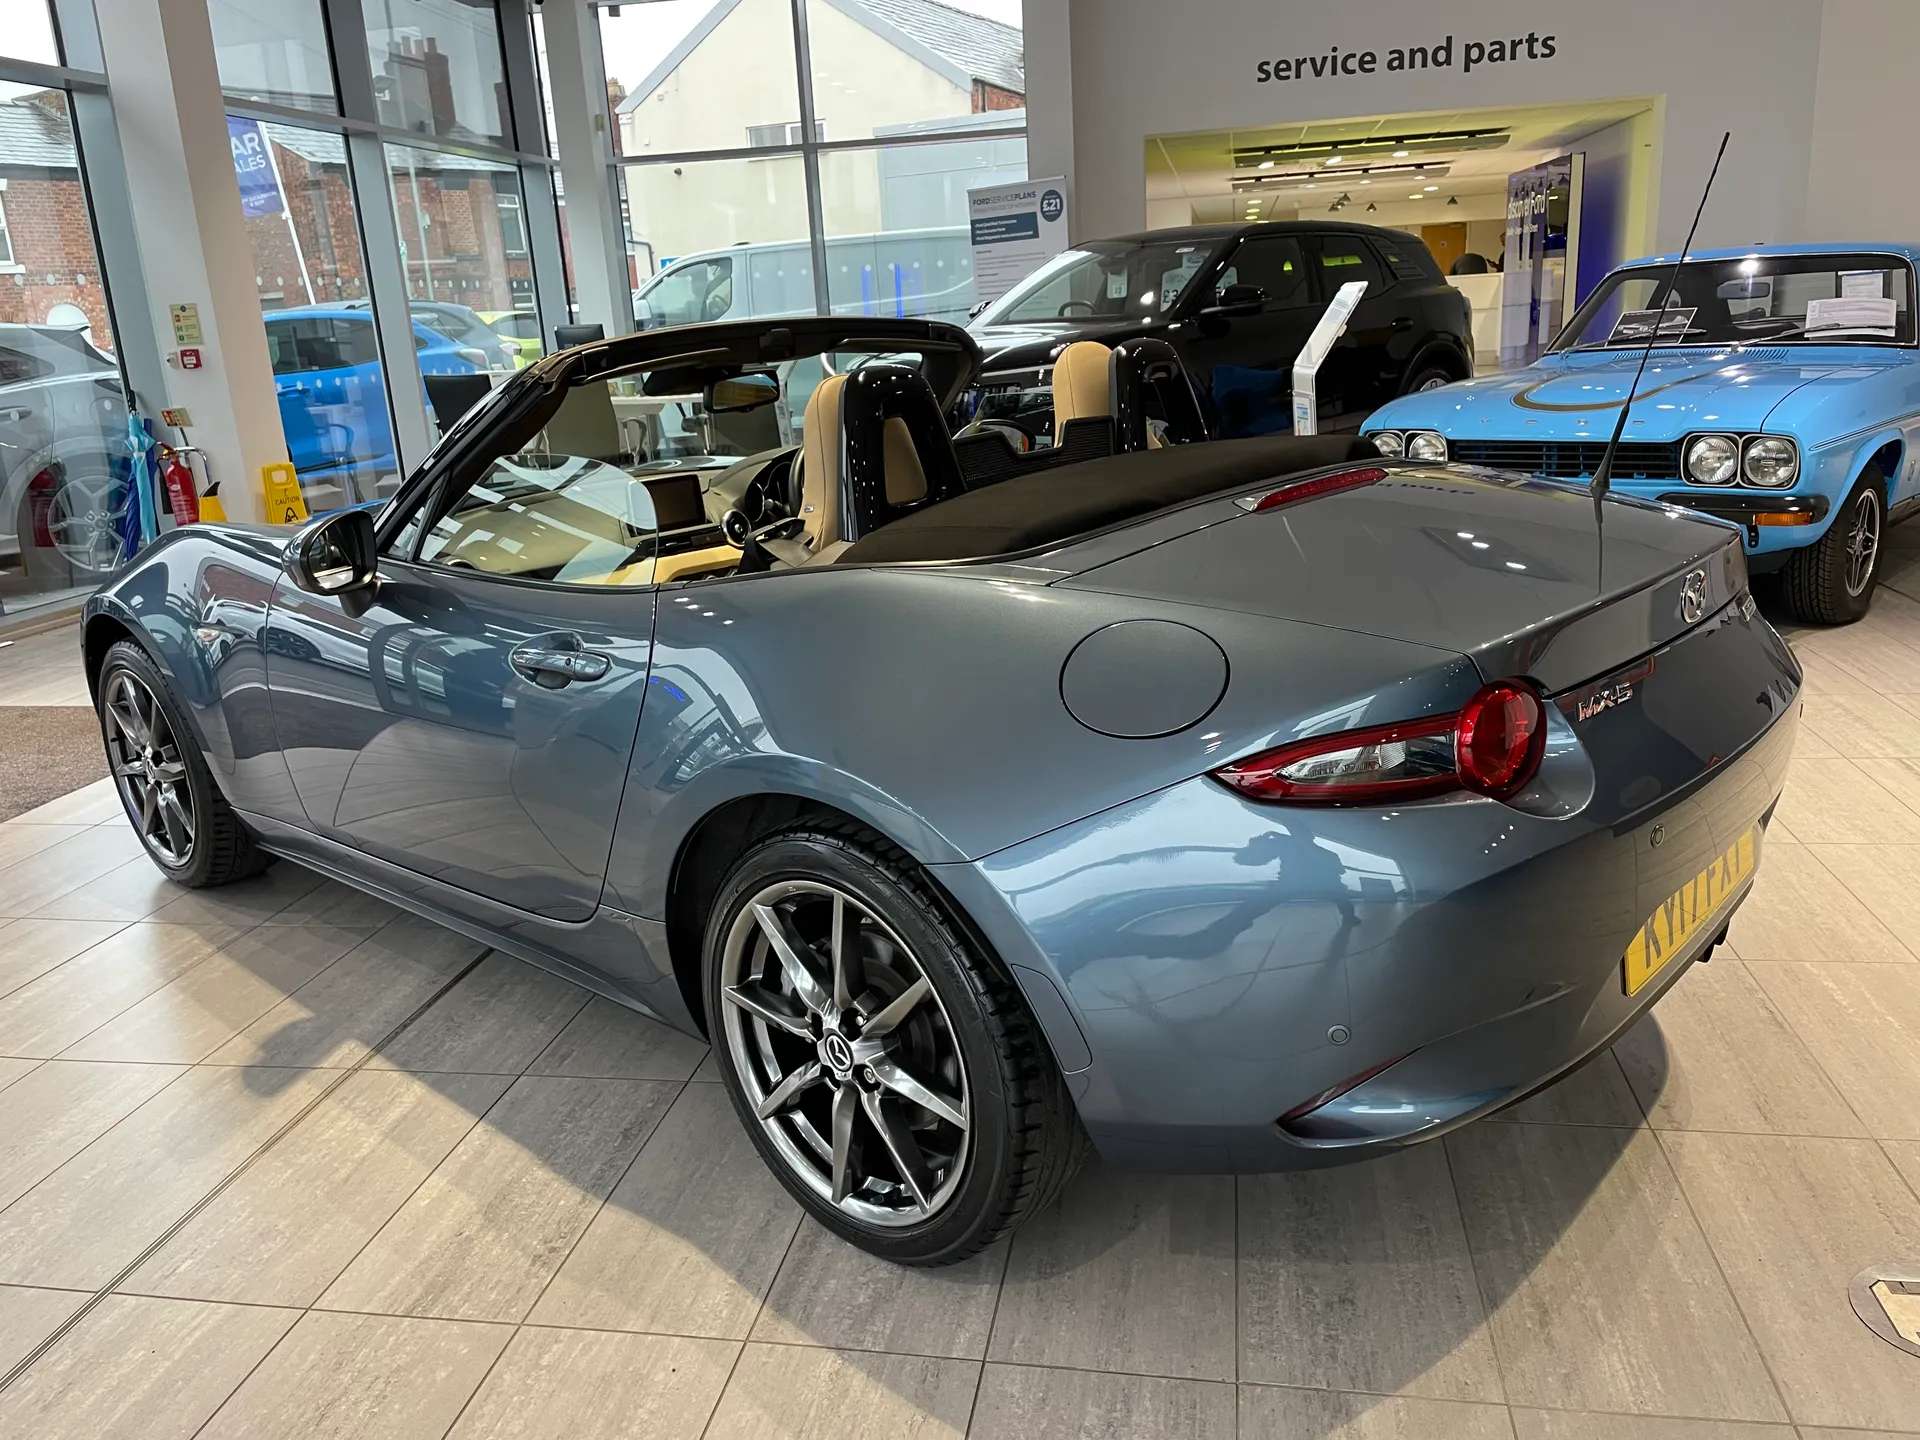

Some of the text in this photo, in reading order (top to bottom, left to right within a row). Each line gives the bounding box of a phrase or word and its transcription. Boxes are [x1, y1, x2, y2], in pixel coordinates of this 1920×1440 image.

[1257, 32, 1556, 83] service and parts
[1042, 198, 1060, 212] £21
[275, 495, 300, 505] CAUTION
[1578, 681, 1633, 721] MX-5
